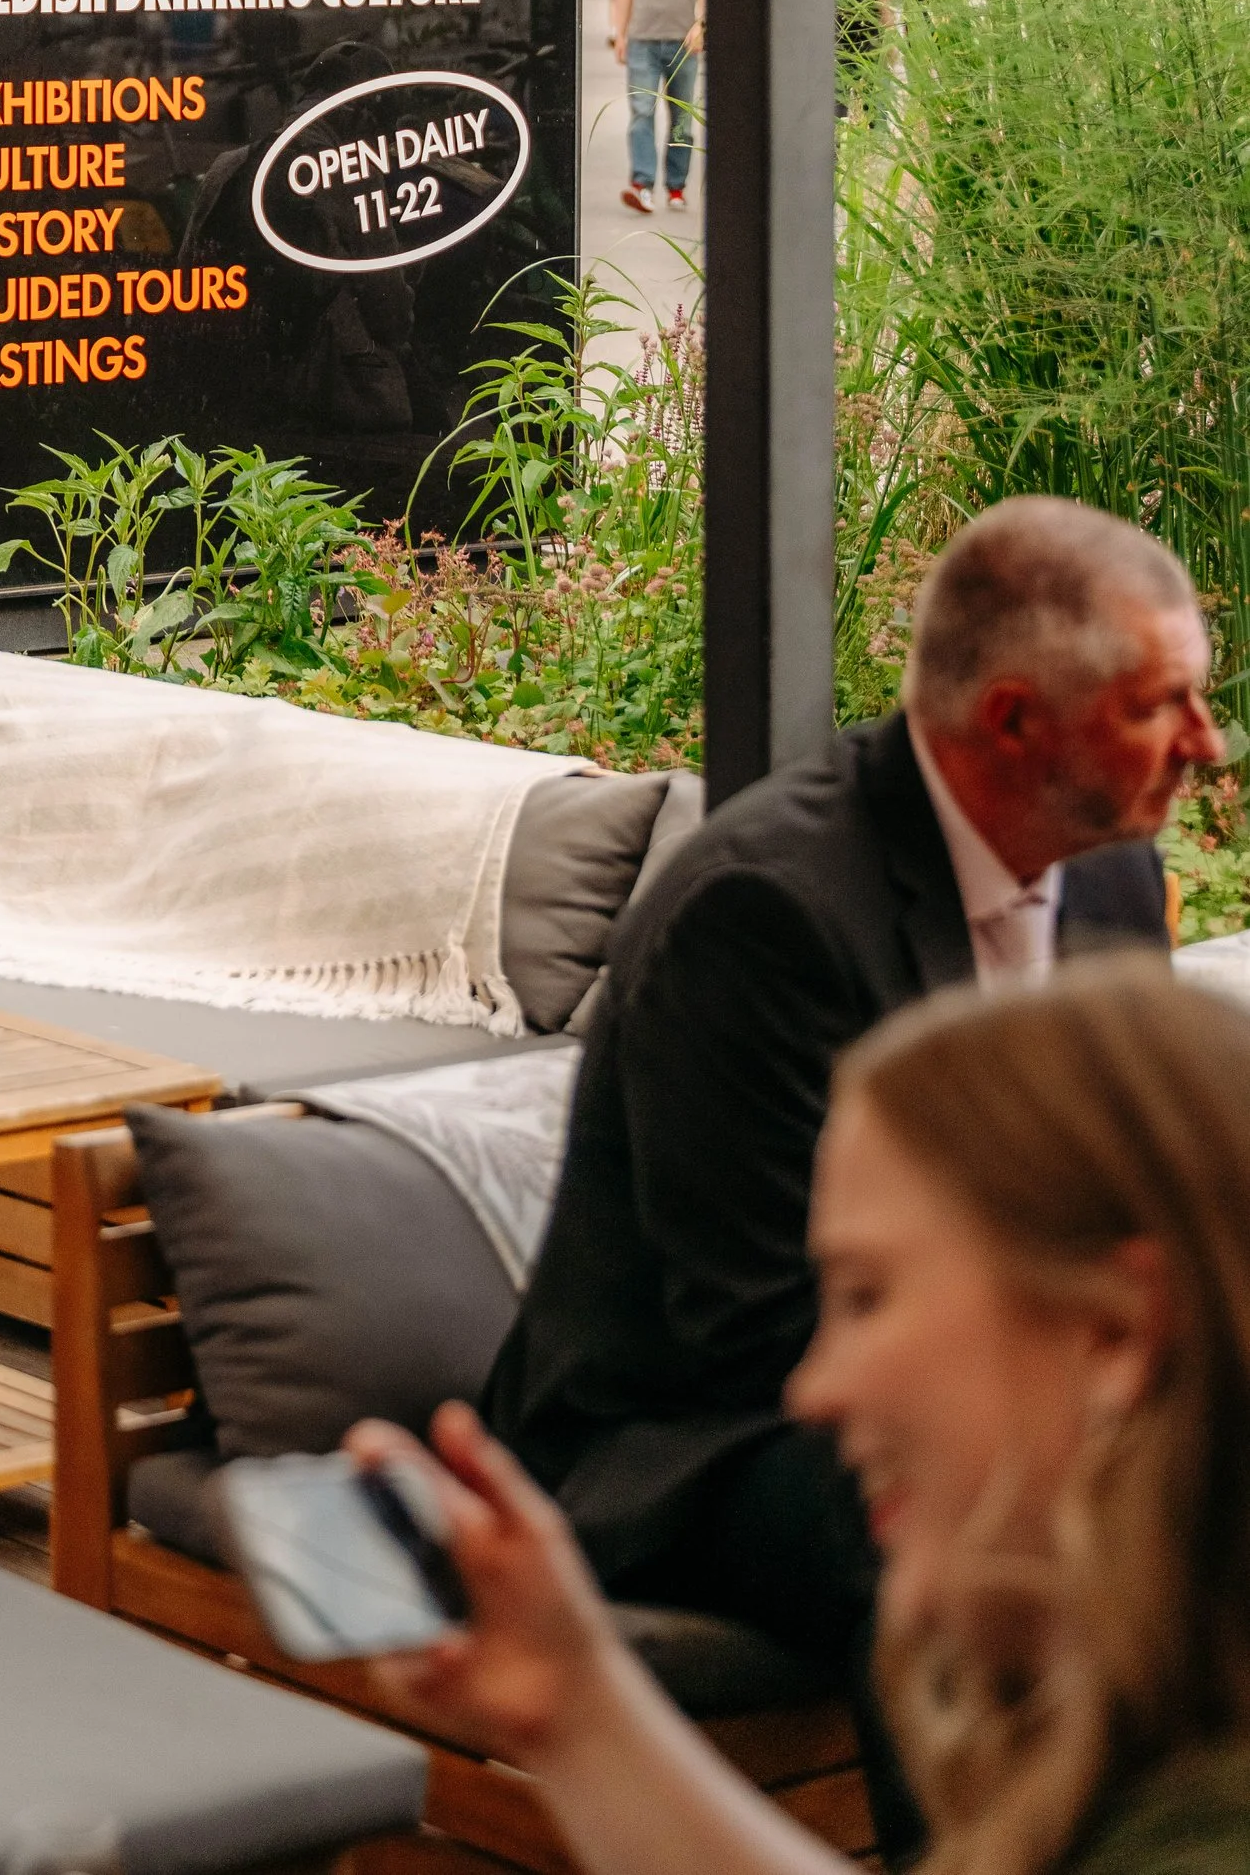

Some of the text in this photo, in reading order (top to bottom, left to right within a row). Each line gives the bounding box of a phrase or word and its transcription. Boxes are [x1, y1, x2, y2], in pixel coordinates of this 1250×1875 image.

[288, 108, 490, 195] OPEN DAILY
[353, 176, 443, 234] 11-22
[117, 264, 249, 315] TOURS
